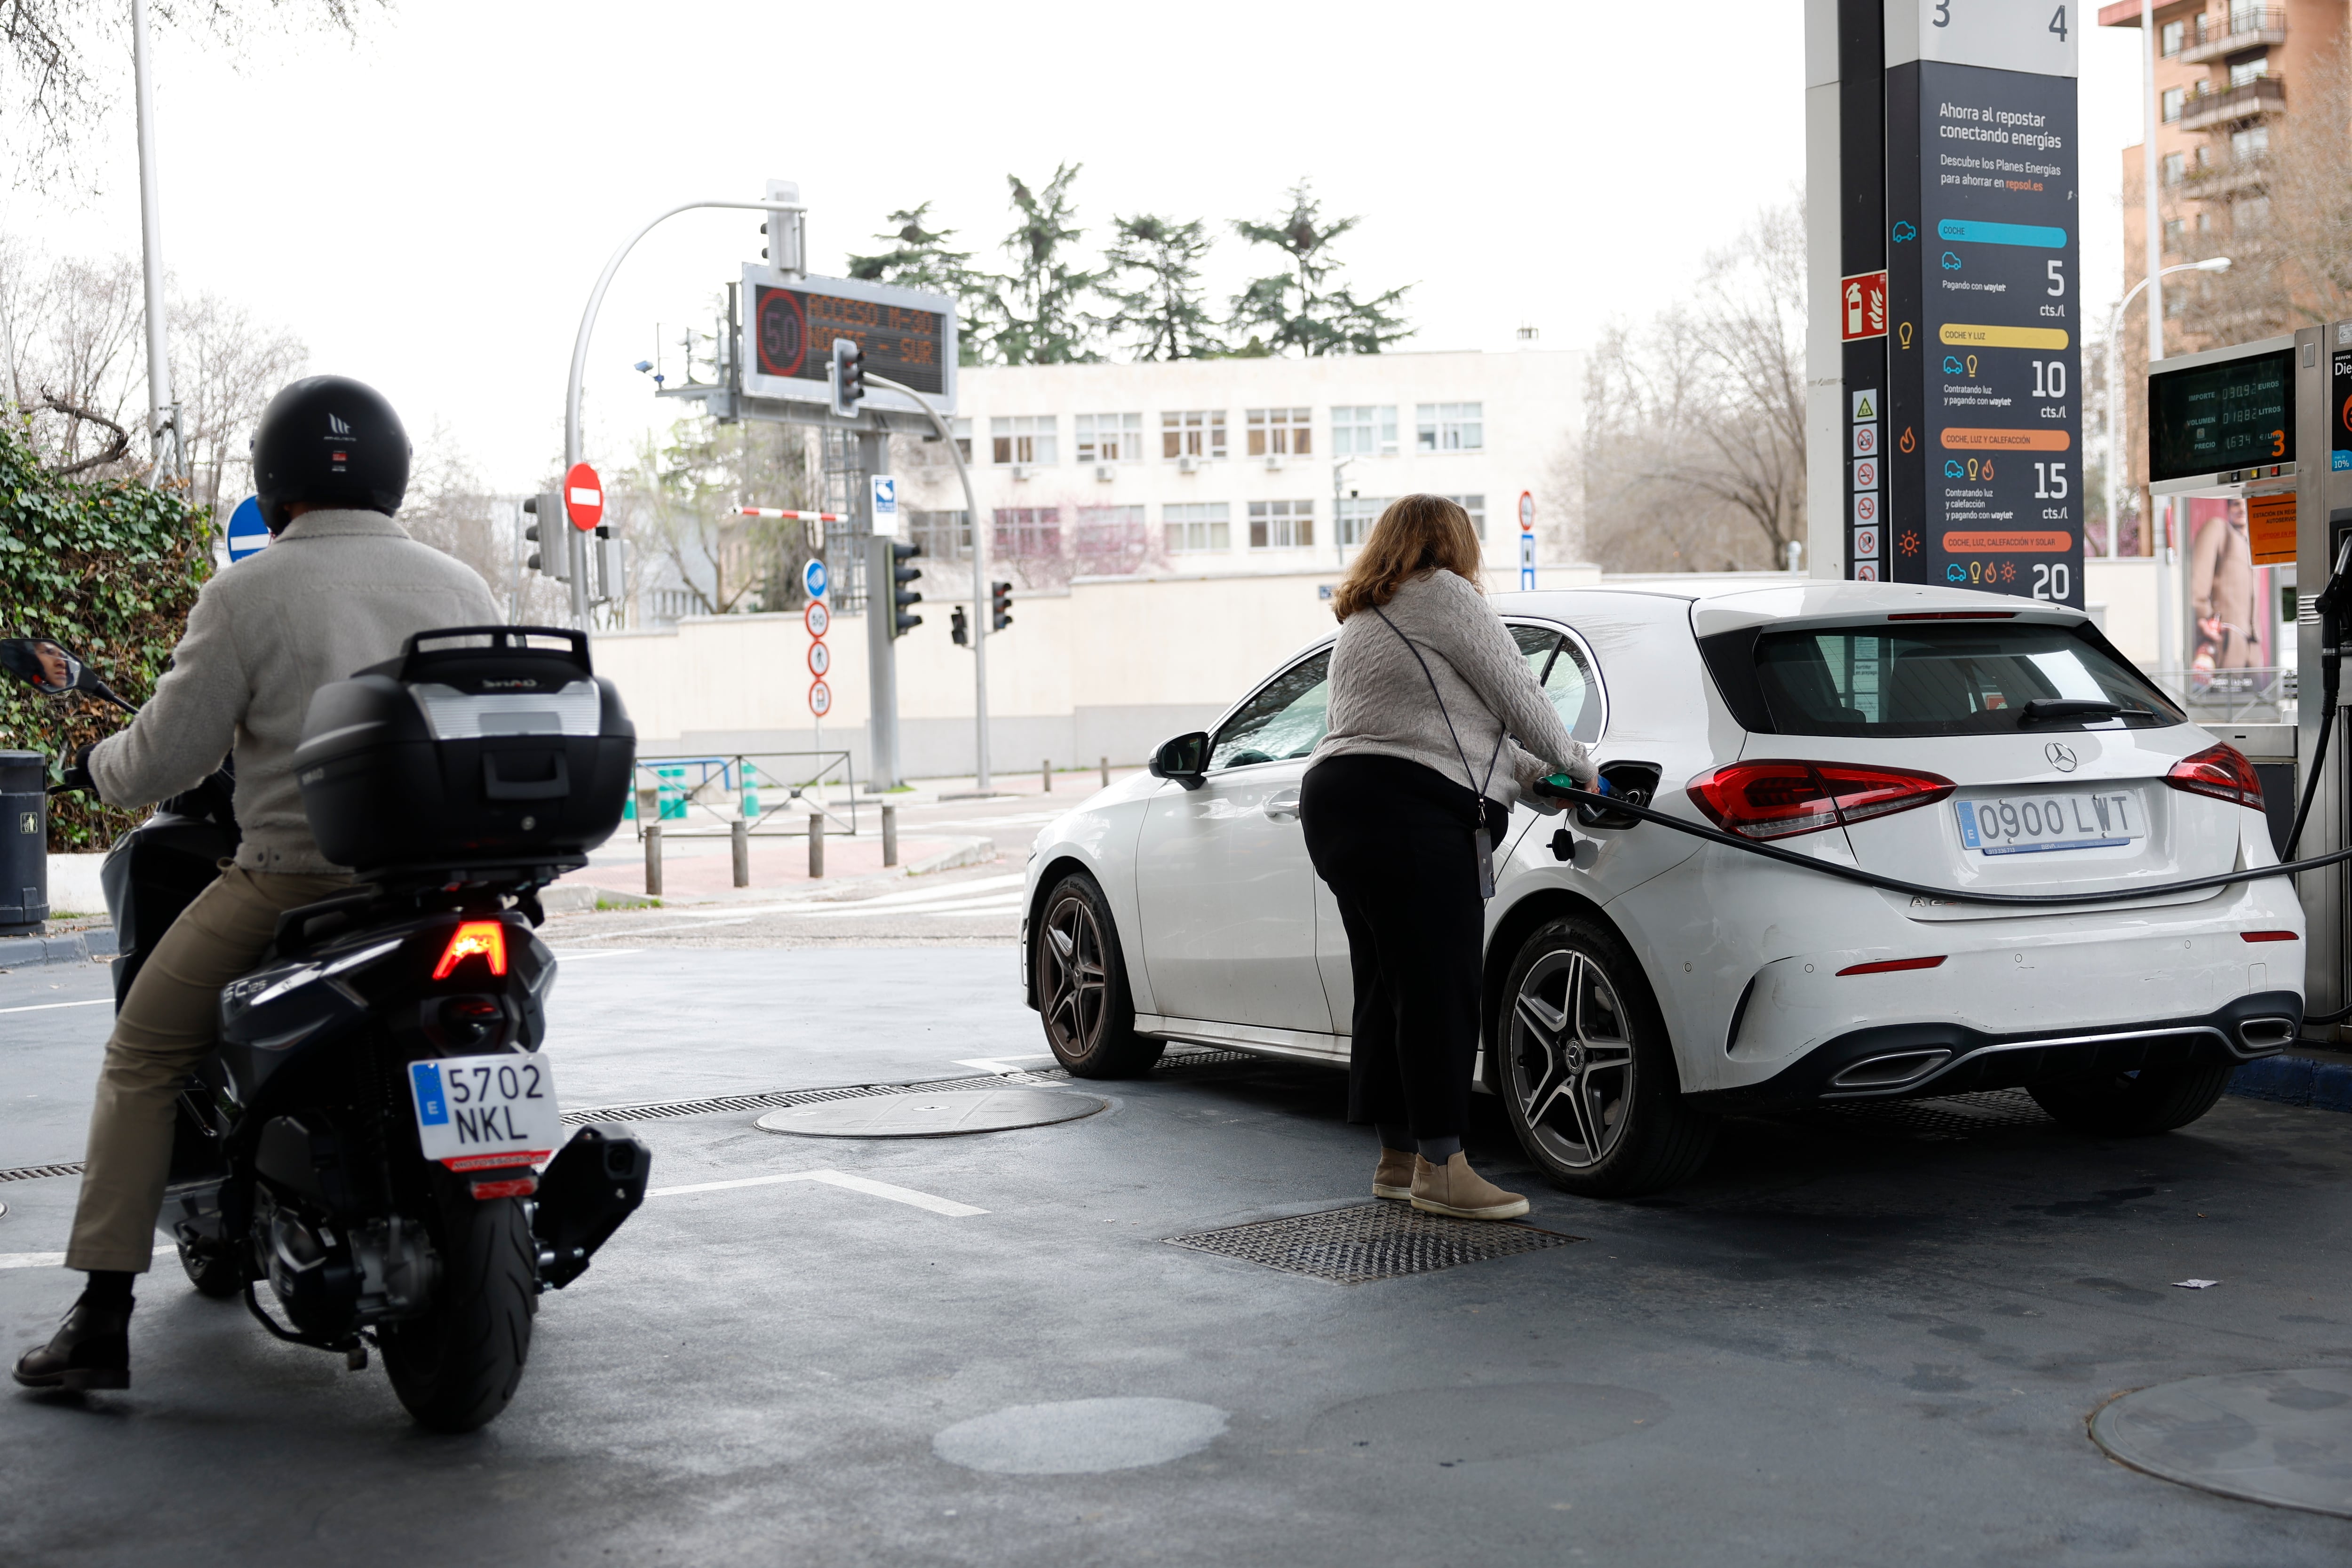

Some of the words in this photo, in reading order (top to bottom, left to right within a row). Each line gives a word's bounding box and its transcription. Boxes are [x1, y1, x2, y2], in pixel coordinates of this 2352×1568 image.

[1932, 0, 1951, 27] 3
[2049, 5, 2067, 42] 4
[1939, 102, 1979, 121] Ahorra
[1982, 106, 1994, 122] al
[1996, 112, 2046, 127] repostar
[1940, 125, 2009, 144] conectando
[2011, 131, 2062, 151] energías
[1940, 154, 1980, 169] Descubre
[1981, 157, 1995, 170] los
[1996, 159, 2024, 173] Planes
[2025, 161, 2062, 177] Energías
[1941, 174, 1961, 186] para
[1962, 174, 1993, 187] ahorrar
[1994, 179, 2005, 188] en
[2006, 179, 2043, 191] repsol.es
[1943, 226, 1965, 235] COCHE
[1942, 279, 1970, 292] Pagando
[2047, 259, 2065, 297] 5
[808, 293, 878, 327] ACCESO
[765, 312, 799, 357] 50
[1945, 330, 1967, 339] COCHE
[2032, 360, 2066, 398] 10
[1944, 384, 1982, 395] Contratando
[1983, 385, 1993, 394] luz
[2189, 391, 2216, 402] IMPORTE
[2258, 381, 2280, 390] EUROS
[1944, 398, 1948, 406] y
[1949, 396, 1976, 406] pagando
[2187, 416, 2216, 426] VOLUMEN
[2258, 406, 2281, 415] LITROS
[1947, 434, 1970, 444] COCHE,
[1989, 434, 2031, 444] CALEFACCIÓN
[2194, 441, 2216, 450] PRECIO
[2271, 430, 2285, 457] 3
[2334, 459, 2350, 469] 10%
[2034, 462, 2068, 499] 15
[1945, 488, 1983, 498] Contratando
[1984, 488, 1994, 497] luz
[1946, 501, 1950, 509] y
[1951, 499, 1986, 508] calefacción
[1946, 512, 1950, 521] y
[1950, 510, 1978, 521] pagando
[1948, 539, 1971, 547] COCHE,
[1972, 539, 1986, 547] LUZ,
[1987, 536, 2029, 546] CALEFACCIÓN
[2032, 563, 2070, 600] 20
[1979, 800, 2065, 839] 0900
[2072, 796, 2129, 833] LWT
[1967, 829, 1975, 839] E
[1911, 896, 1926, 907] A
[448, 1065, 543, 1104] 5702
[426, 1101, 439, 1115] E
[454, 1105, 528, 1145] NKL
